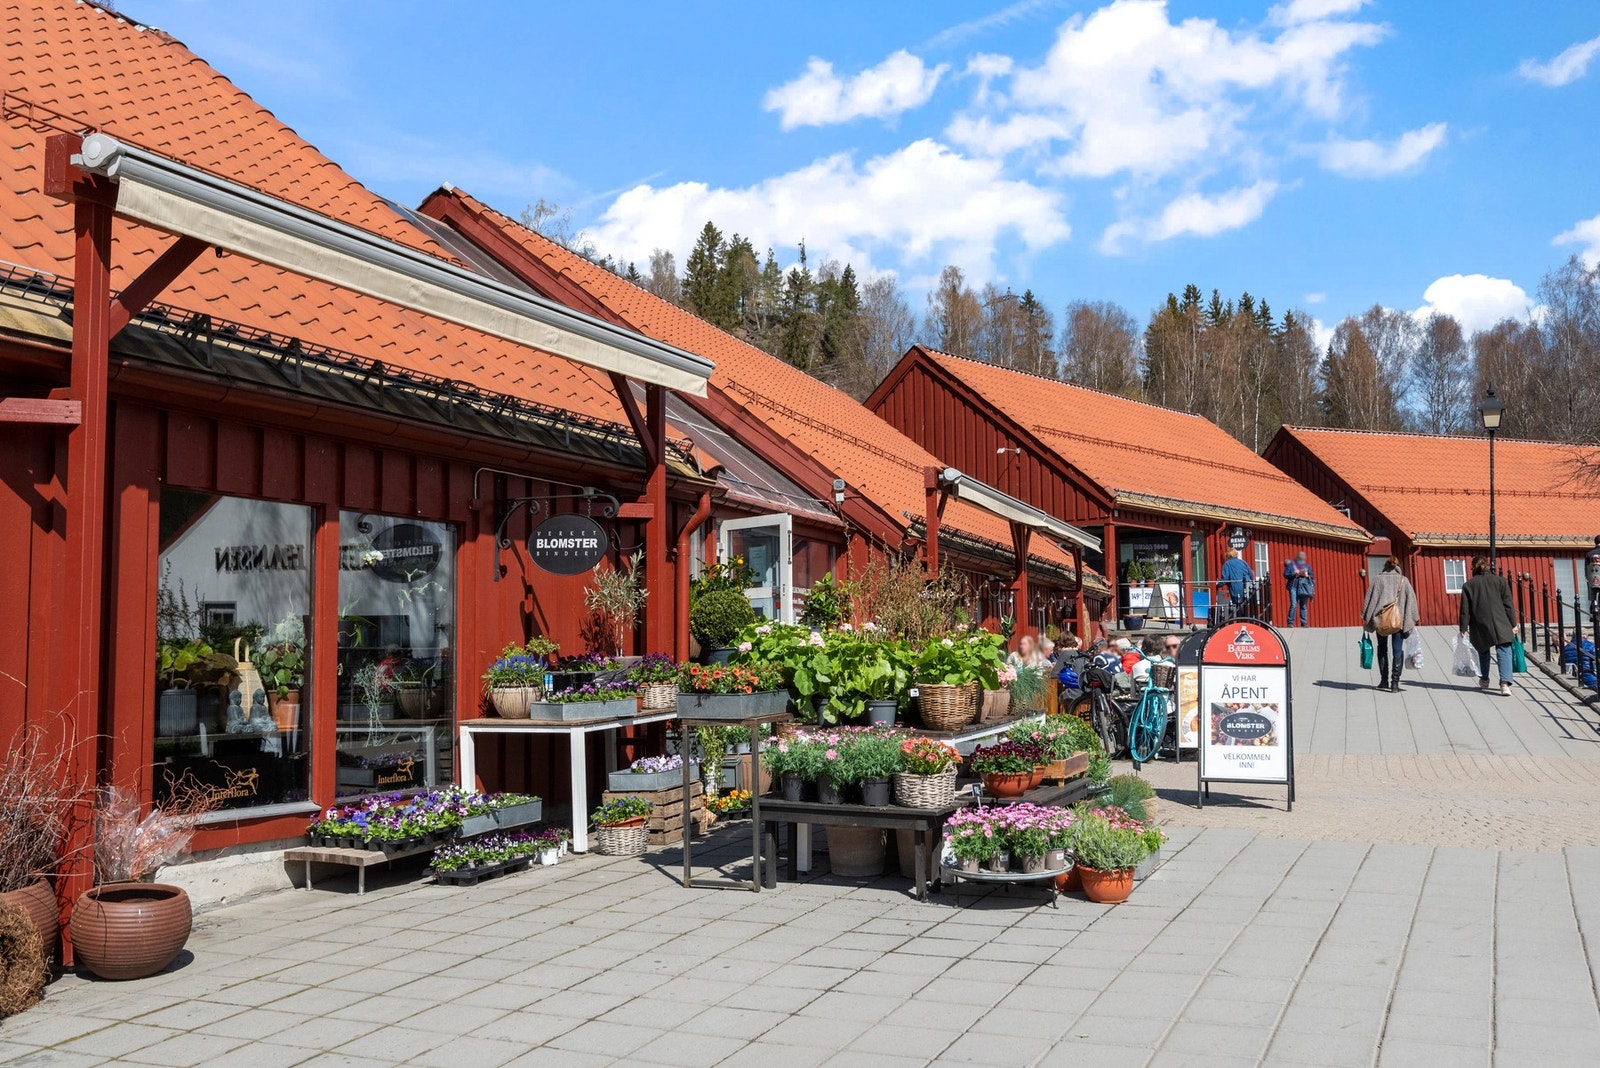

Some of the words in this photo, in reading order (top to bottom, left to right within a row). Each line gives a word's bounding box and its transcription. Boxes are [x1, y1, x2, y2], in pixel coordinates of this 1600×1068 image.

[536, 538, 598, 548] BLOMSTER
[1228, 644, 1260, 652] BÆRUMS
[1234, 652, 1254, 660] VERK
[1221, 684, 1268, 699] ÅPENT
[378, 773, 407, 784] Interflora
[212, 786, 248, 799] Interflora
